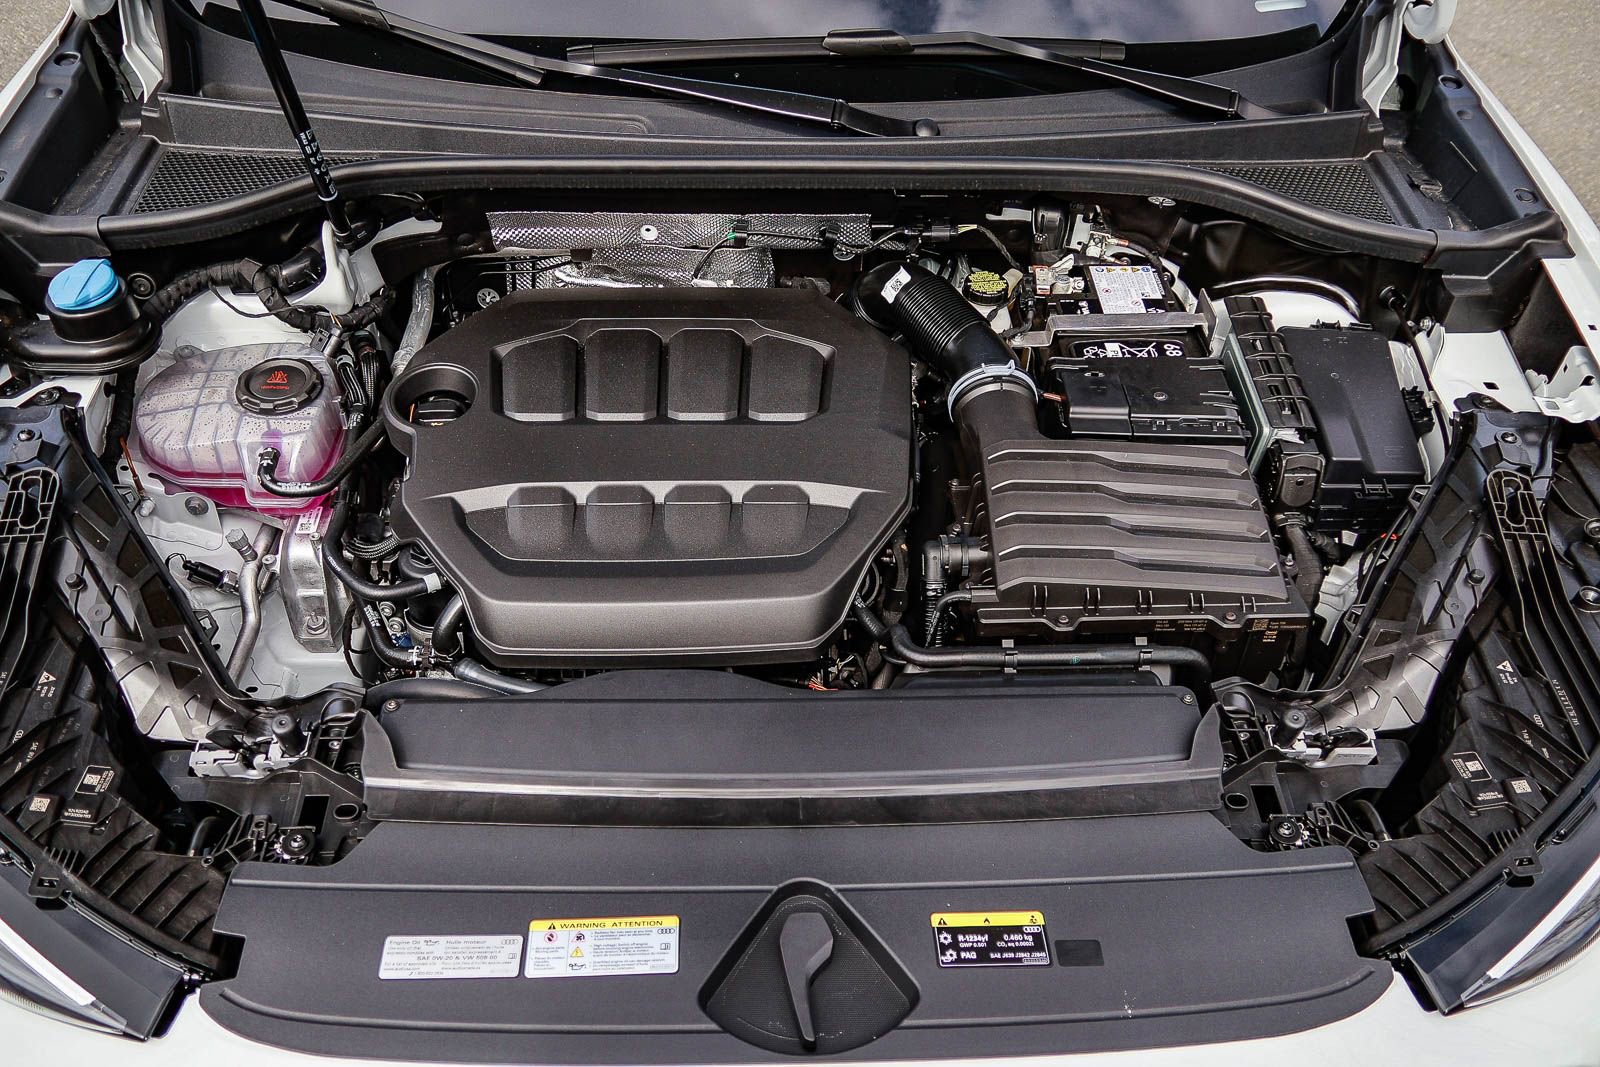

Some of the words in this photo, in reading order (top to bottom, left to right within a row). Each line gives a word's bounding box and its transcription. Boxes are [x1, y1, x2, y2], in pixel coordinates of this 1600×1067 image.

[1163, 343, 1182, 357] 68
[612, 920, 663, 928] ATTENTION
[1023, 933, 1033, 942] kg
